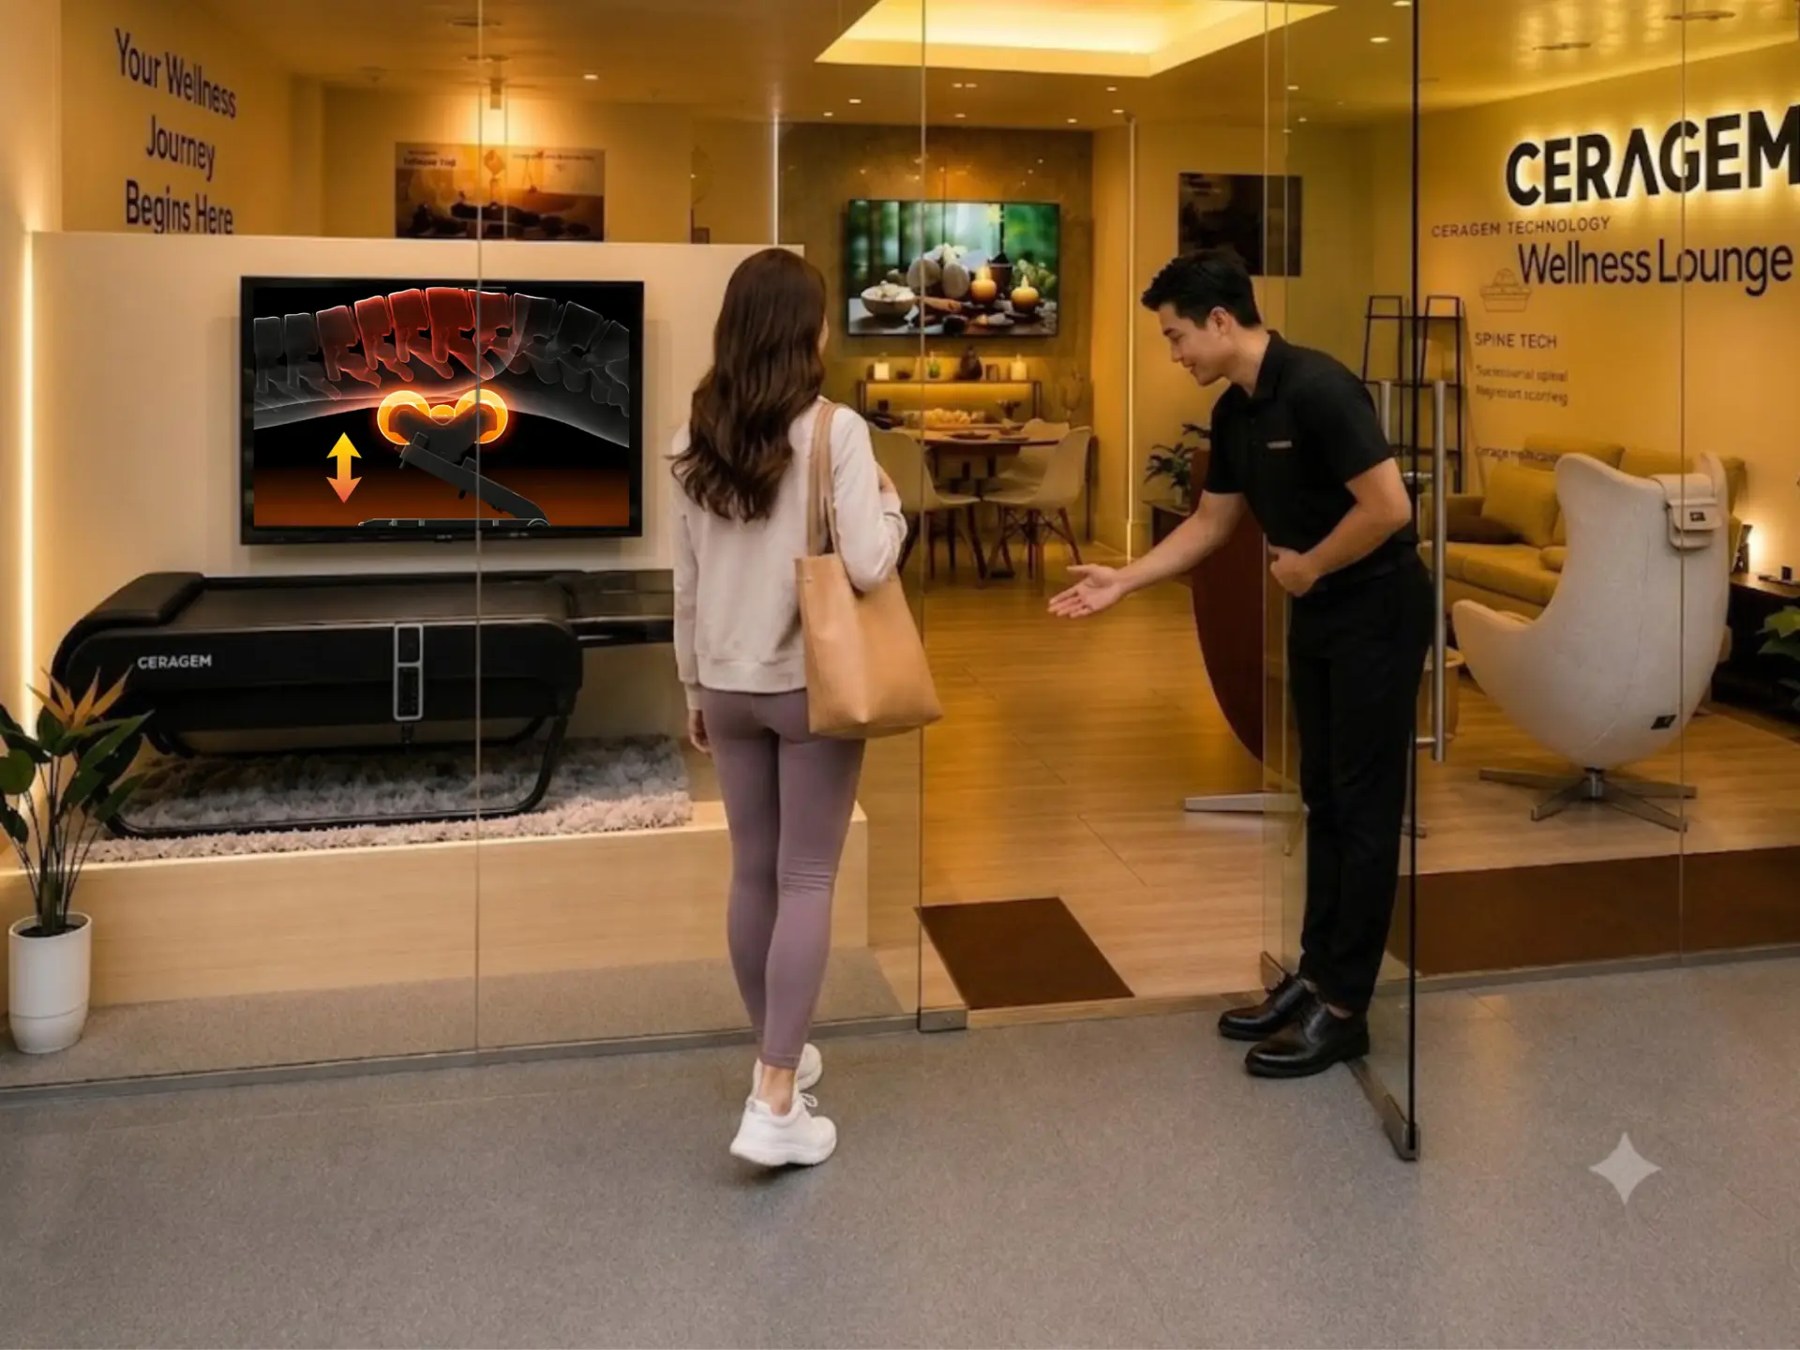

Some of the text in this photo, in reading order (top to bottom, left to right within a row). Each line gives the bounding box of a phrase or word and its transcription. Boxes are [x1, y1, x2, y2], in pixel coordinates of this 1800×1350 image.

[115, 27, 236, 119] Your Wellness
[146, 114, 215, 182] Journey
[1506, 104, 1800, 206] CERAGEM
[126, 179, 233, 234] Begins Here
[1508, 216, 1611, 235] TECHNOLOGY
[1518, 238, 1793, 297] Wellness Lounge
[1475, 332, 1557, 349] SPINE TECH
[137, 654, 212, 670] CERAGEM
